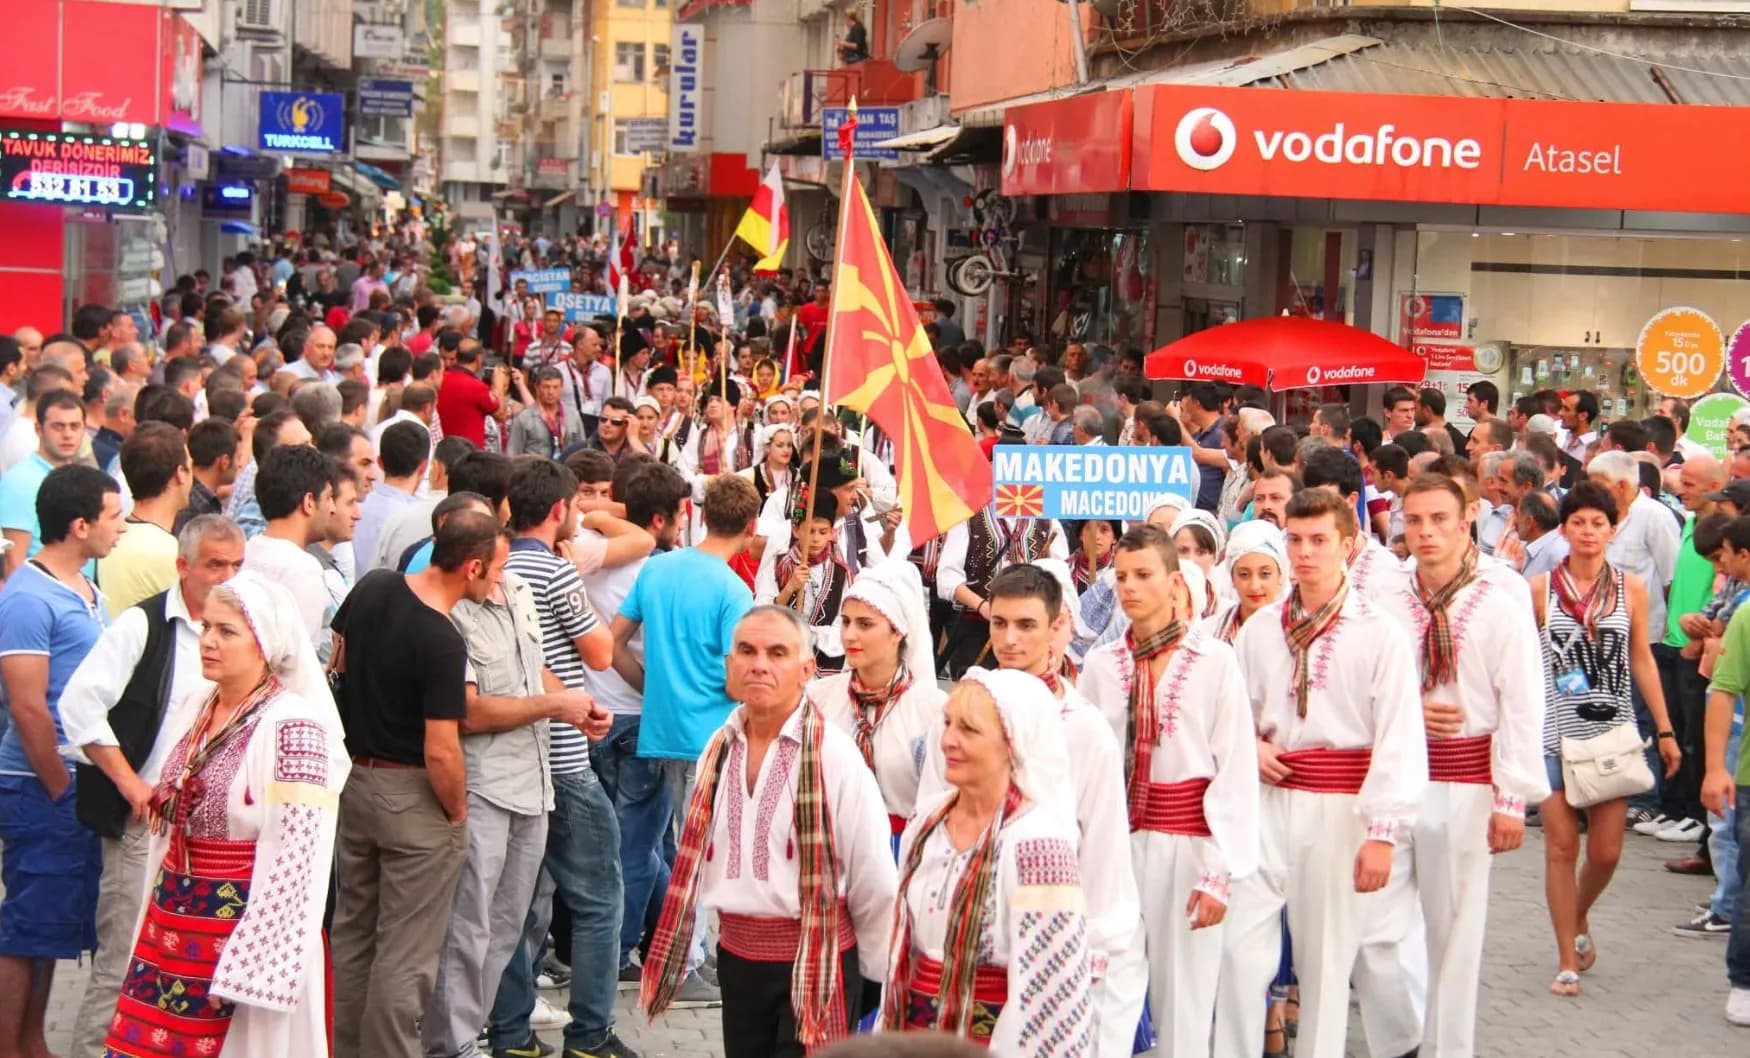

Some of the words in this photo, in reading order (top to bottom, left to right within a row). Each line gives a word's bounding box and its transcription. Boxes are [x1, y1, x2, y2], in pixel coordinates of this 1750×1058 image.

[672, 31, 697, 145] kurular
[0, 86, 54, 112] Fast
[62, 92, 132, 118] Food
[3, 138, 56, 157] TAVUK
[264, 134, 334, 149] TURKCELL
[1254, 123, 1481, 168] vodafone
[1523, 142, 1622, 174] Atasel
[555, 292, 611, 312] OSETYA
[1199, 364, 1242, 379] vodafone
[1324, 366, 1375, 380] vodafone
[1656, 351, 1705, 375] 500
[1671, 374, 1687, 386] dk
[996, 453, 1188, 484] MAKEDONYA
[1061, 490, 1161, 516] MACEDON
